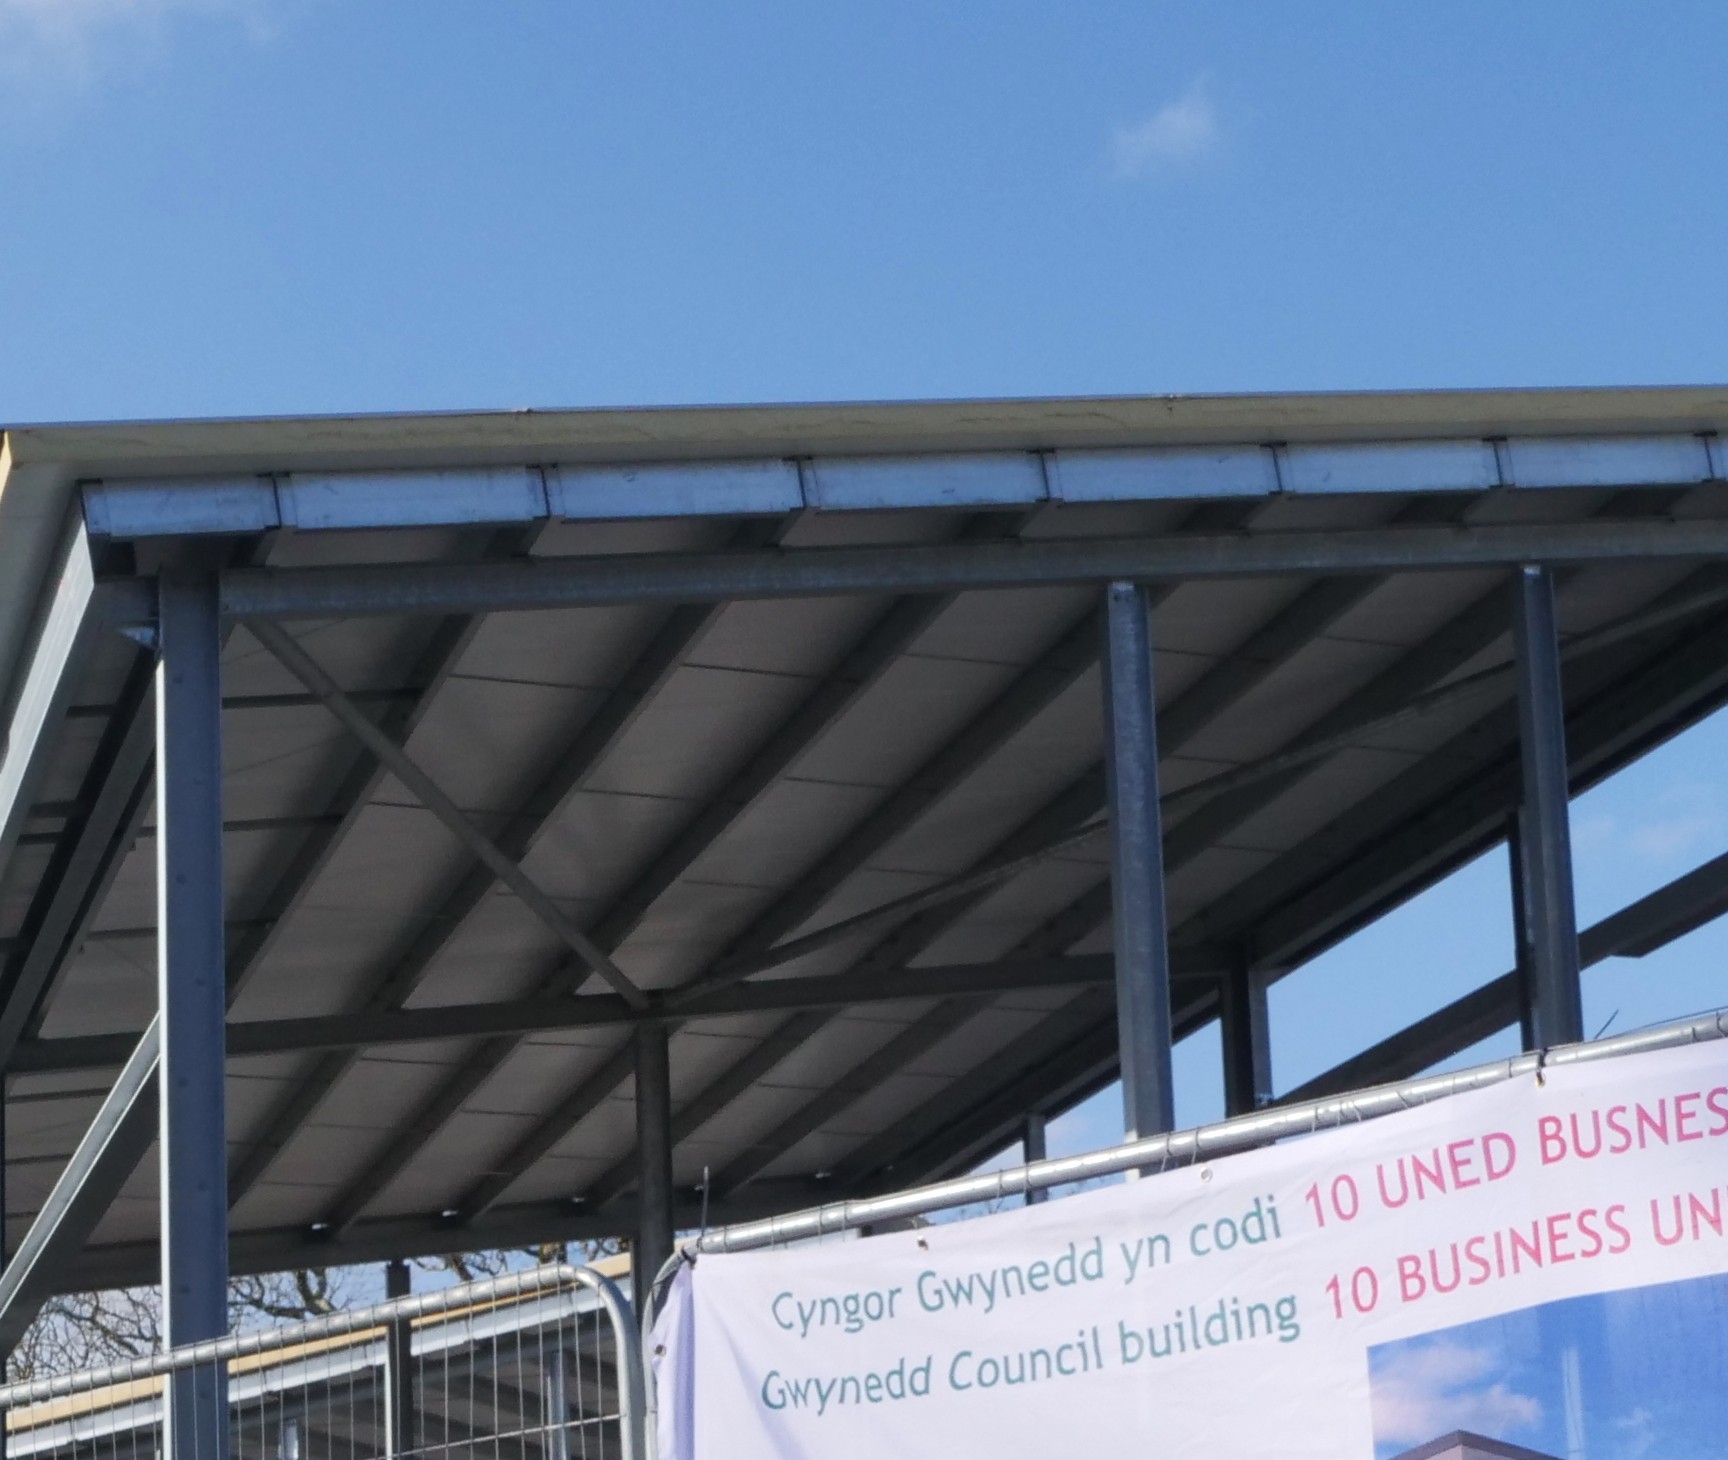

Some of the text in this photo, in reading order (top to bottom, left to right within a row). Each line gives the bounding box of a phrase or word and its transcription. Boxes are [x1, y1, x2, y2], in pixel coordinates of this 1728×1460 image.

[761, 1346, 931, 1417] Gwynedd
[948, 1327, 1103, 1391] Council
[1120, 1290, 1301, 1364] building
[1325, 1265, 1379, 1320] 10
[1398, 1204, 1632, 1304] BUSINESS
[771, 1279, 903, 1338] Cyngor
[916, 1237, 1104, 1312] Gwynedd
[1121, 1233, 1170, 1282] yn
[1189, 1194, 1281, 1257] codi
[1305, 1173, 1359, 1229] 10
[1376, 1132, 1516, 1210] UNED
